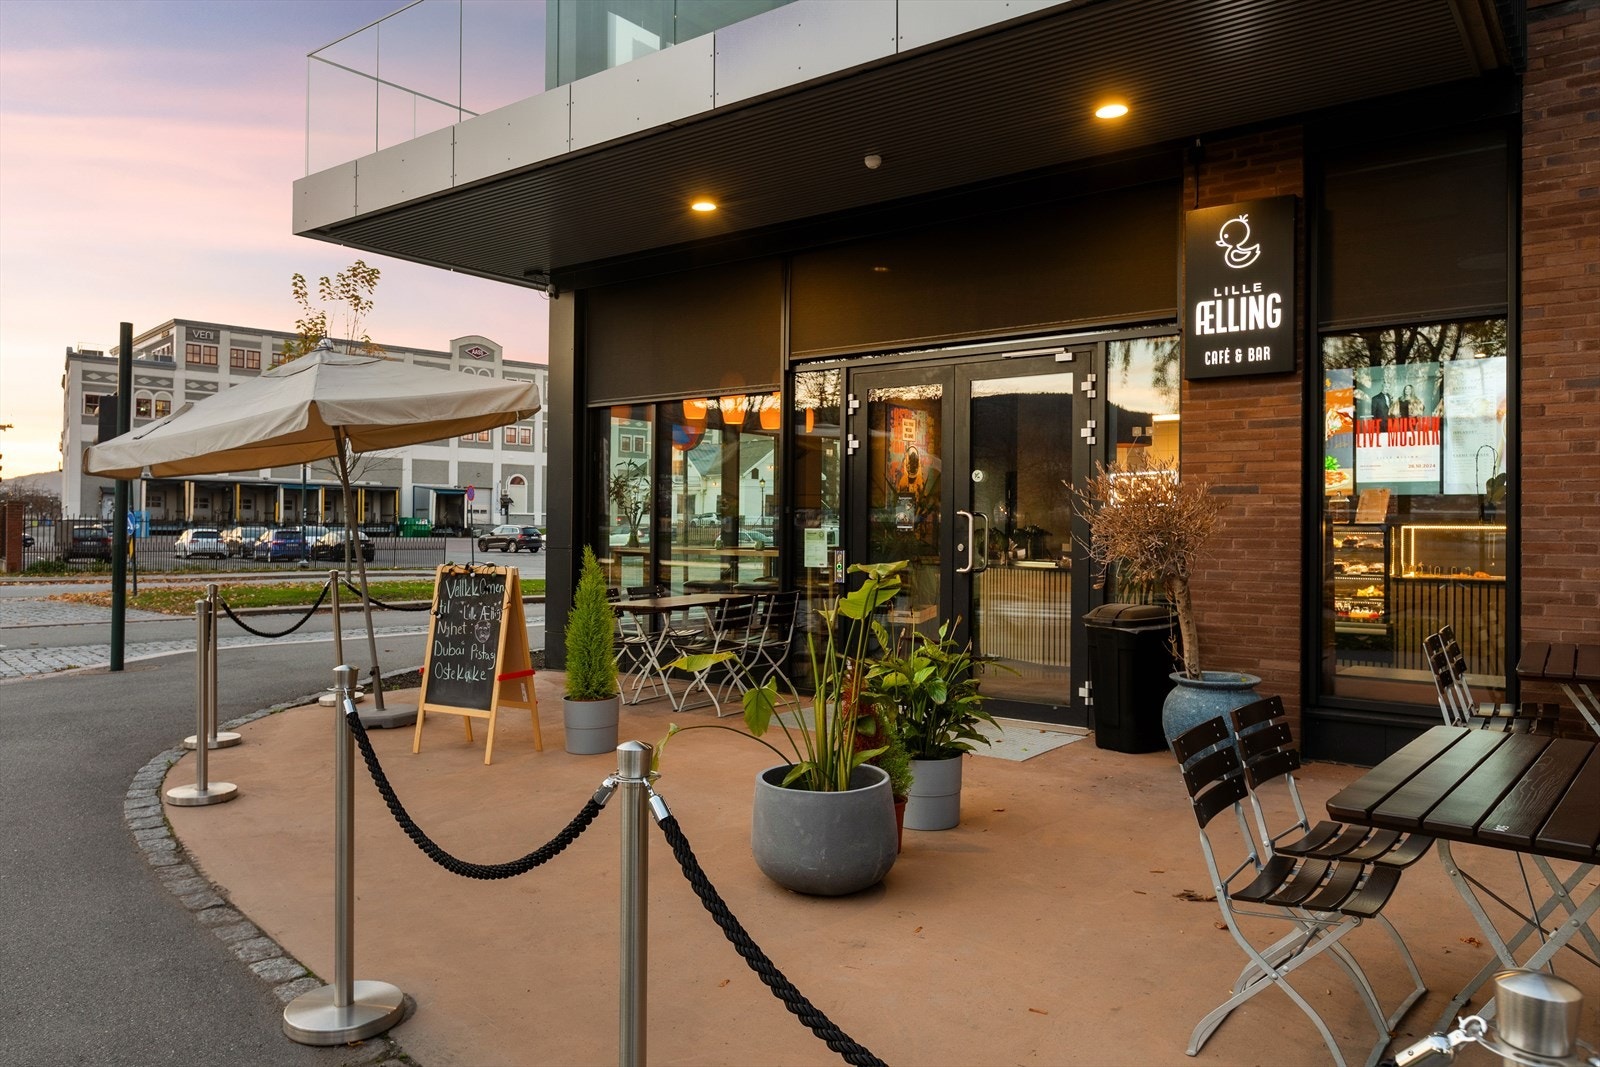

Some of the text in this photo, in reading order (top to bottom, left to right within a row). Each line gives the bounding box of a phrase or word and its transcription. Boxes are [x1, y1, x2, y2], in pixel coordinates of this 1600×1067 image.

[1213, 282, 1262, 297] LILLE
[1195, 293, 1282, 335] ÆLLING
[1204, 346, 1271, 366] CAFÉ & BAR
[1356, 418, 1382, 448] LIVE
